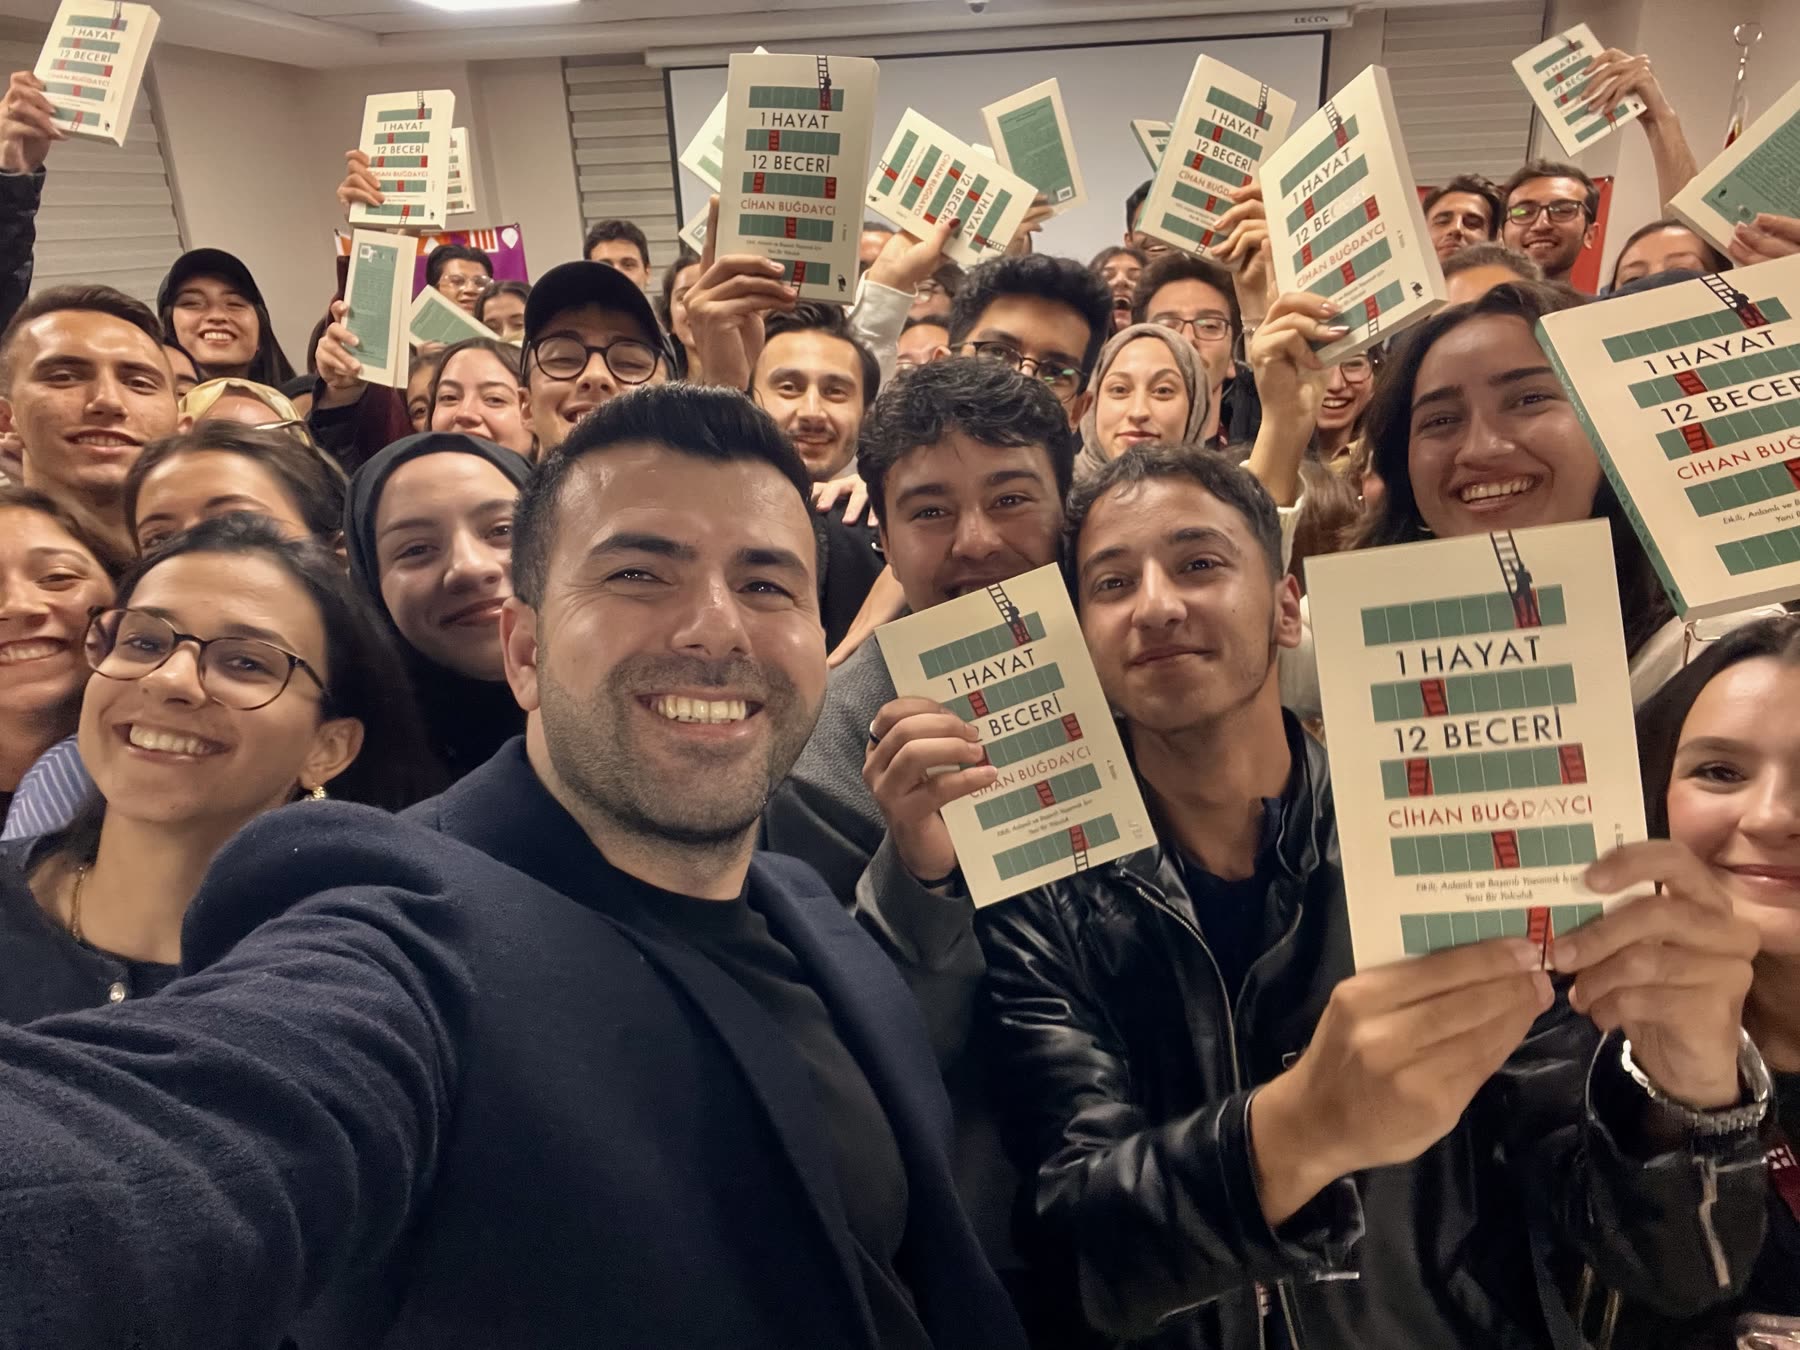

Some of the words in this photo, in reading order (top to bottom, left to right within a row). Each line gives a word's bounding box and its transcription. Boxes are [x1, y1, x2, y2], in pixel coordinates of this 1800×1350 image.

[78, 28, 115, 40] HAYAT
[60, 49, 70, 58] 12
[390, 122, 424, 131] HAYAT
[761, 112, 766, 127] 1
[772, 112, 829, 130] HAYAT
[1220, 112, 1260, 140] HAYAT
[377, 146, 386, 154] 12
[1194, 138, 1208, 154] 12
[752, 154, 767, 170] 12
[774, 155, 831, 174] BECERİ
[1302, 147, 1351, 198] HAYAT
[960, 173, 973, 187] 12
[740, 198, 775, 211] CİHAN
[778, 200, 836, 216] BUĞDAYCI
[964, 198, 992, 238] HAYAT
[1296, 227, 1310, 247] 12
[1644, 360, 1658, 375] 1
[1666, 329, 1776, 370] HAYAT
[1661, 403, 1699, 425] 12
[1677, 450, 1752, 480] CİHAN
[1396, 650, 1406, 676] 1
[1421, 634, 1540, 674] HAYAT
[946, 677, 958, 695] 1
[963, 648, 1036, 690] HAYAT
[988, 692, 1063, 737] BECERİ
[1394, 726, 1430, 752] 12
[1444, 706, 1563, 749] BECERİ
[1018, 745, 1092, 781] BUĞDAYCI
[1388, 805, 1463, 829] CİHAN
[1472, 794, 1593, 823] BUĞDAYCI
